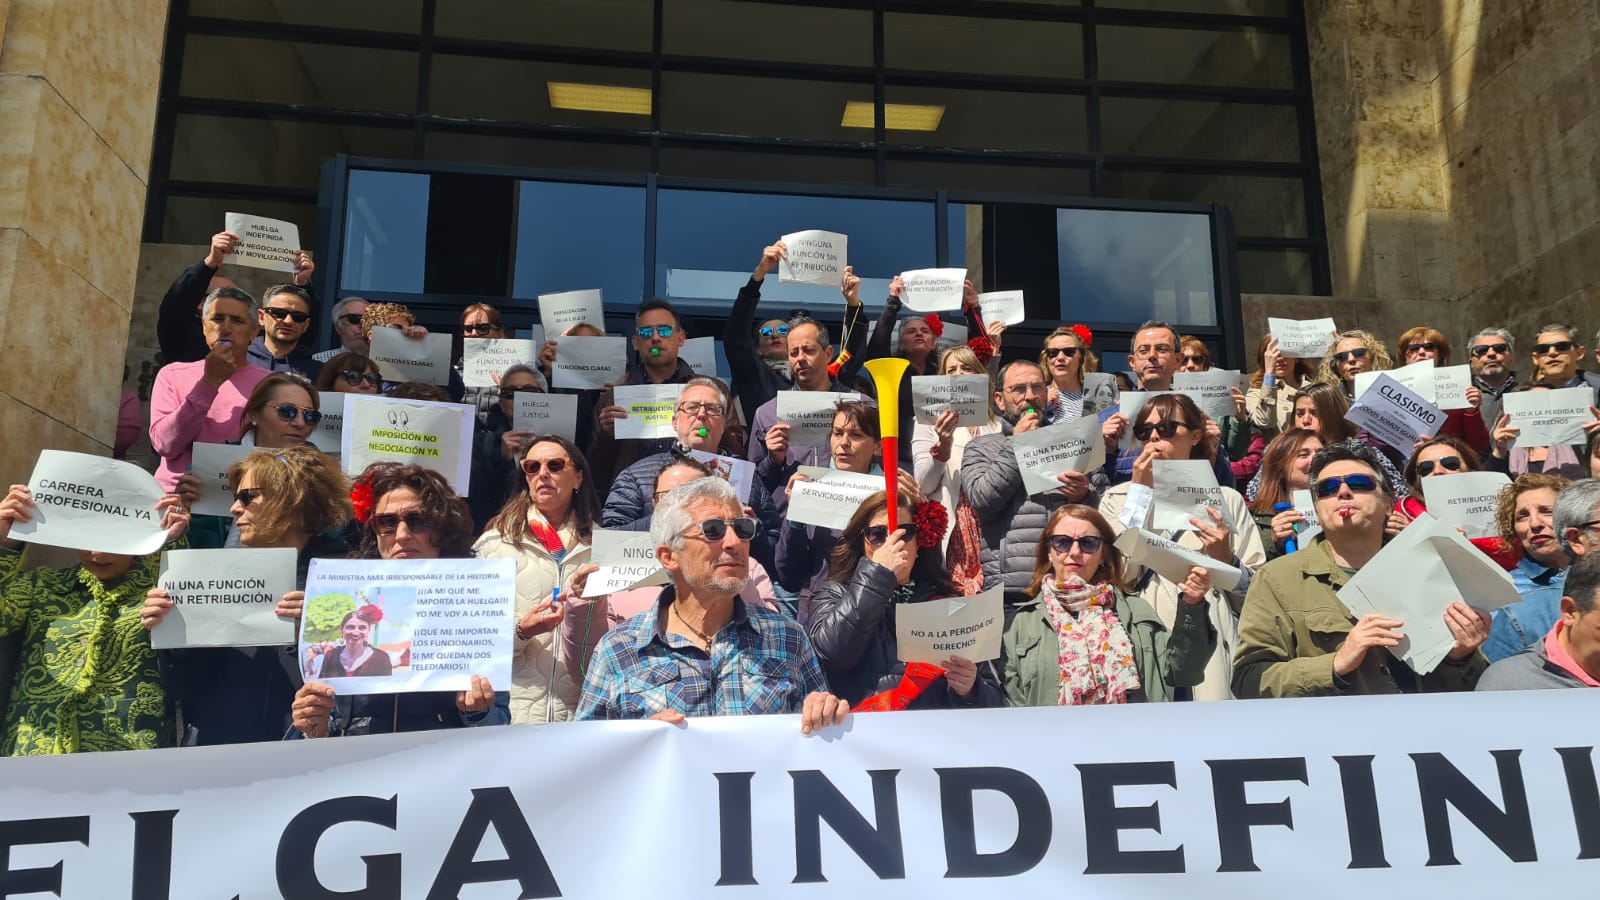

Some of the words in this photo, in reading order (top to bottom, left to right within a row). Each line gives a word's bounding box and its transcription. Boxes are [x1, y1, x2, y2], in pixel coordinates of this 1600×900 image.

[252, 224, 279, 233] HUELGA
[246, 231, 283, 241] INDEFINIDA
[799, 240, 832, 249] NINGUNA
[793, 250, 825, 260] FUNCIÓN
[791, 262, 837, 272] RETRIBUCIÓN
[375, 356, 410, 366] FUNCIONES
[1380, 385, 1436, 424] CLASISMO
[372, 429, 421, 441] IMPOSICIÓN
[369, 443, 425, 455] NEGOCIACIÓN
[1033, 447, 1049, 457] UNA
[1026, 460, 1039, 468] SIN
[39, 479, 104, 498] CARRERA
[802, 488, 844, 501] SERVICIOS
[35, 492, 129, 517] PROFESIONAL
[135, 509, 151, 520] YA
[624, 548, 653, 558] NING
[612, 565, 656, 576] FUNCIÓ
[164, 581, 174, 590] NI
[179, 580, 204, 590] UNA
[208, 577, 265, 590] FUNCIÓN
[188, 592, 272, 604] RETRIBUCIÓN
[950, 622, 984, 636] PERDIDA
[985, 618, 995, 626] DE
[933, 637, 976, 651] DERECHOS
[0, 786, 563, 900] ELGA
[714, 746, 1600, 886] INDEFINI
